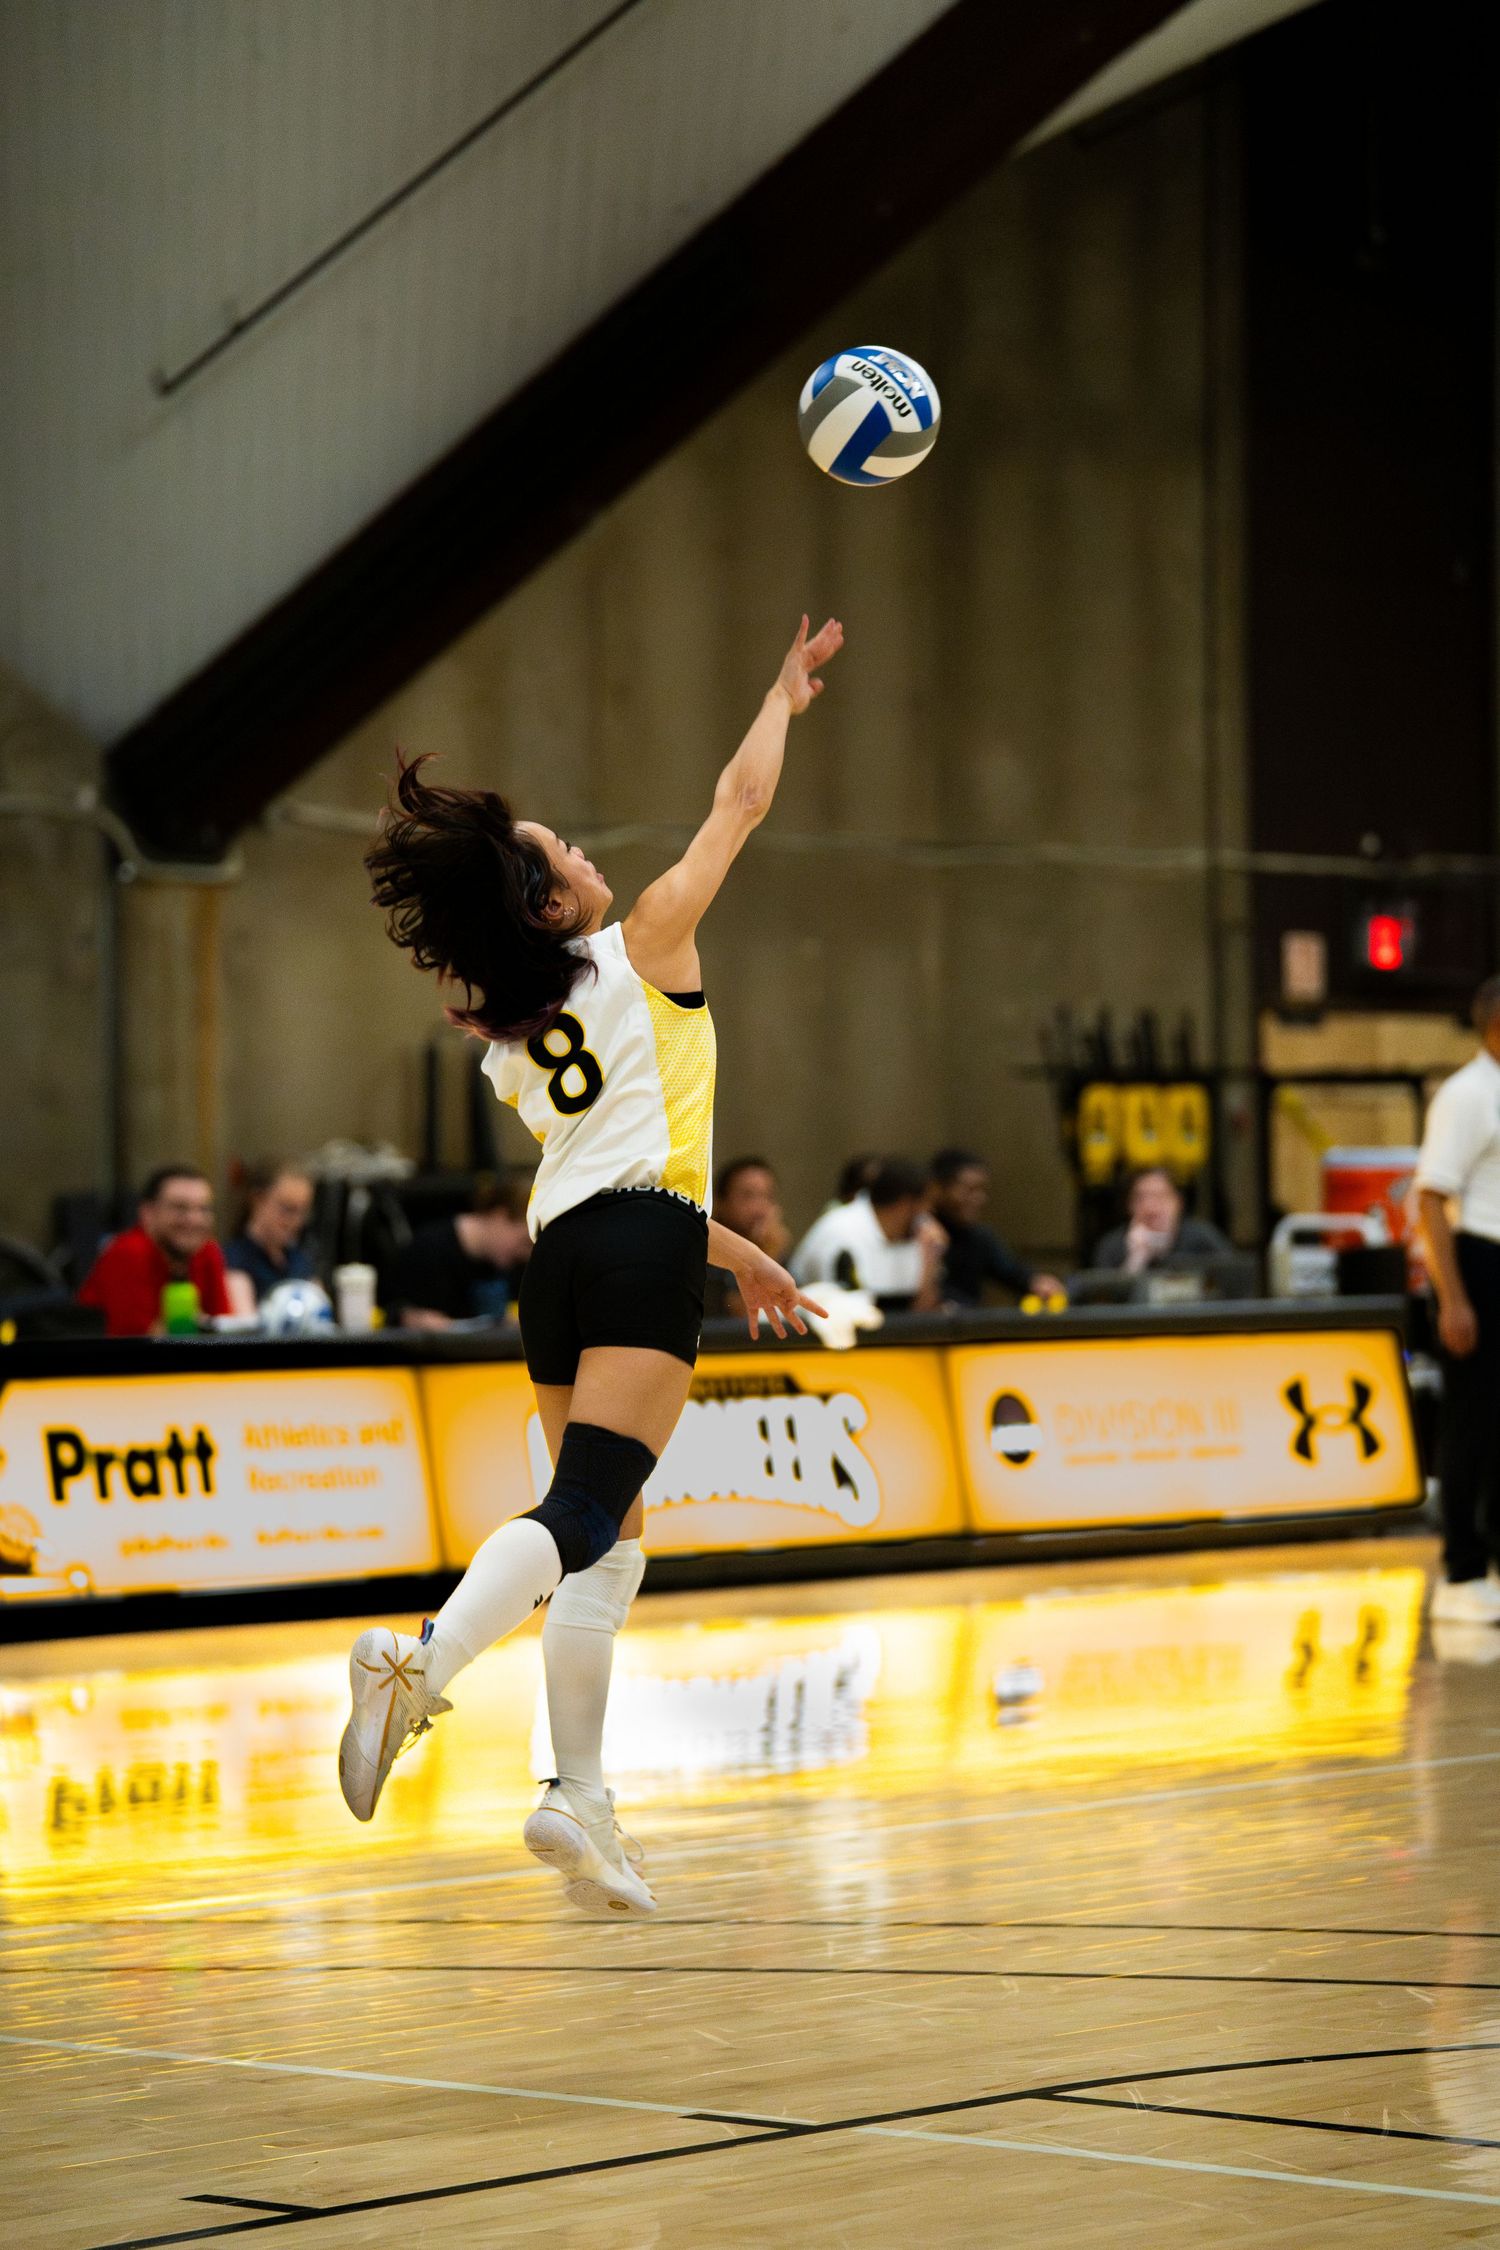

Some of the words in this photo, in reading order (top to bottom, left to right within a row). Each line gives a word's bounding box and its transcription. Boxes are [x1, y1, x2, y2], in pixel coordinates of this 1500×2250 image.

[851, 360, 912, 418] molten
[525, 1010, 605, 1118] 8
[44, 1426, 215, 1503] Pratt
